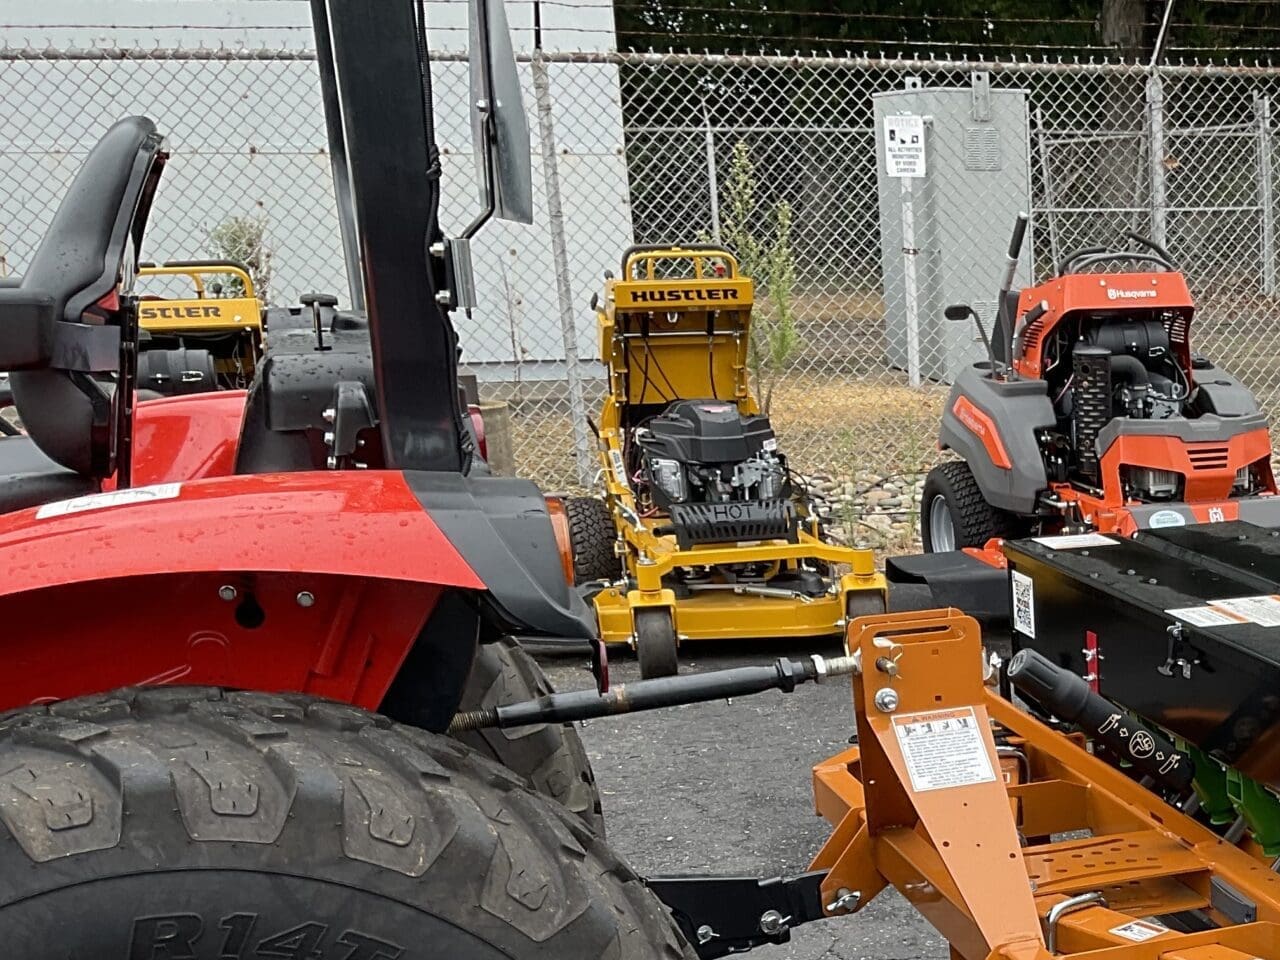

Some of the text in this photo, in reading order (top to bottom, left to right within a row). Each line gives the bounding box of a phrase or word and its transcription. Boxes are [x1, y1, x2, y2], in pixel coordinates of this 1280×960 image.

[630, 288, 739, 303] HUSTLER
[1116, 289, 1158, 299] Husqvarna
[141, 305, 221, 319] STLER
[713, 503, 755, 521] HOT
